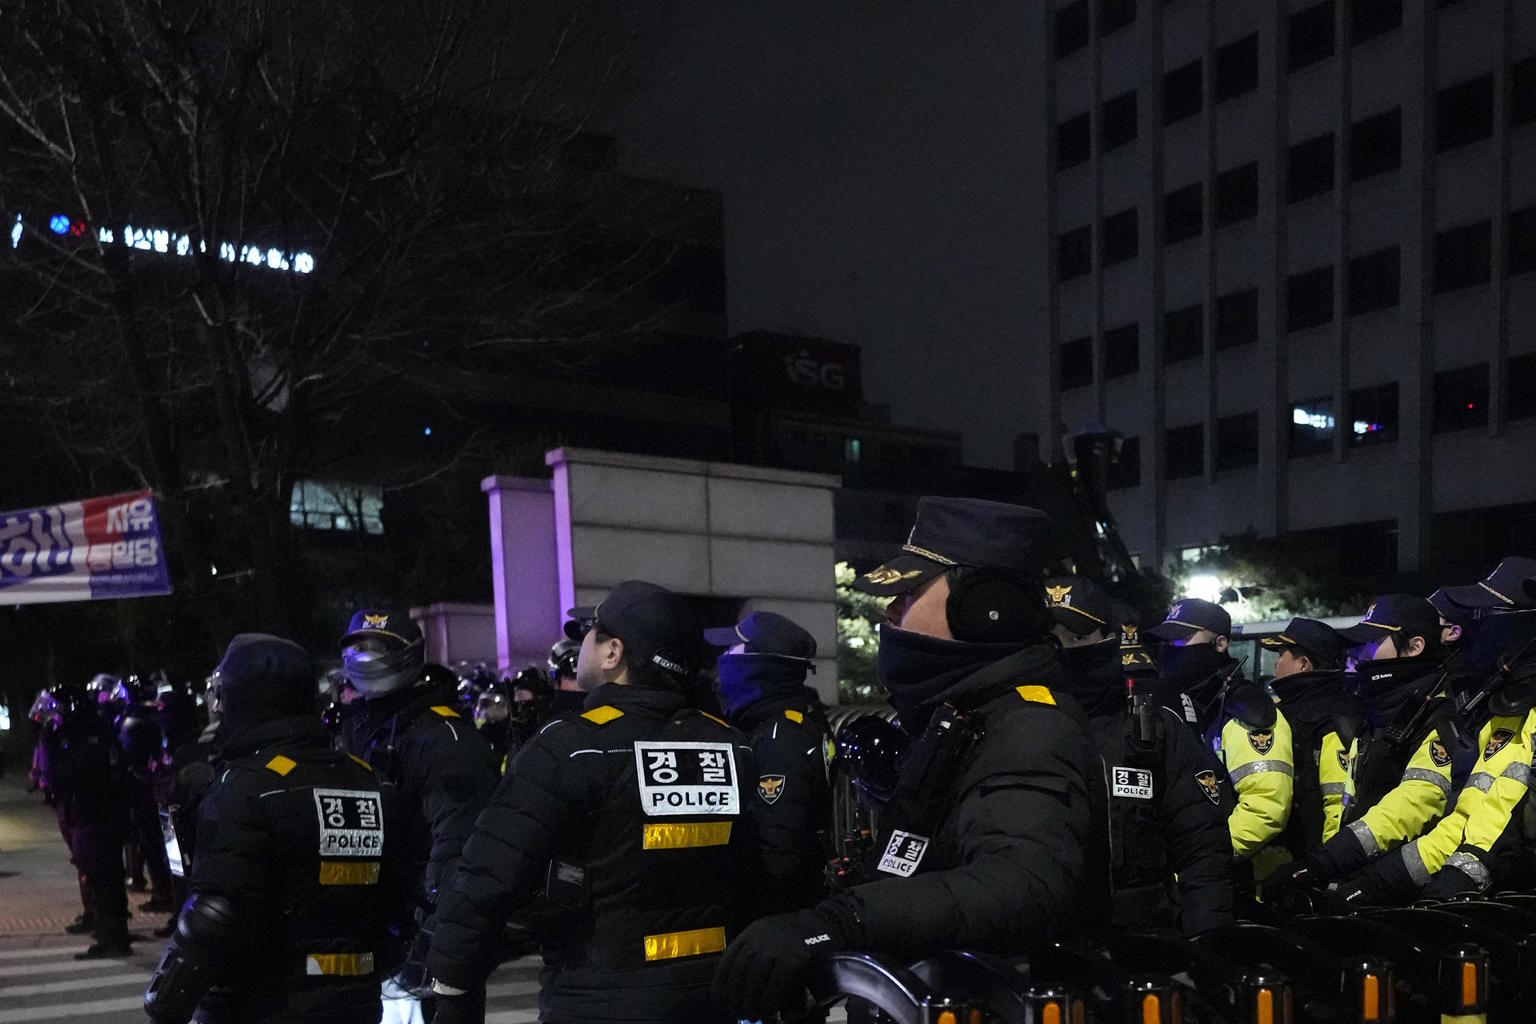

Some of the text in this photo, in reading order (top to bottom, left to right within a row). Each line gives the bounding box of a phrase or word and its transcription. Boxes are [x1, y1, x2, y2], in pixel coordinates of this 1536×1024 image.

[106, 498, 154, 534] 자유
[648, 751, 726, 783] 경찰
[1117, 770, 1149, 787] 경찰
[652, 791, 729, 806] POLICE
[1117, 787, 1149, 796] POLICE
[323, 798, 377, 828] 경찰
[328, 835, 379, 849] POLICE
[887, 836, 922, 861] 경찰
[883, 859, 913, 873] POLICE
[804, 933, 831, 946] POLICE
